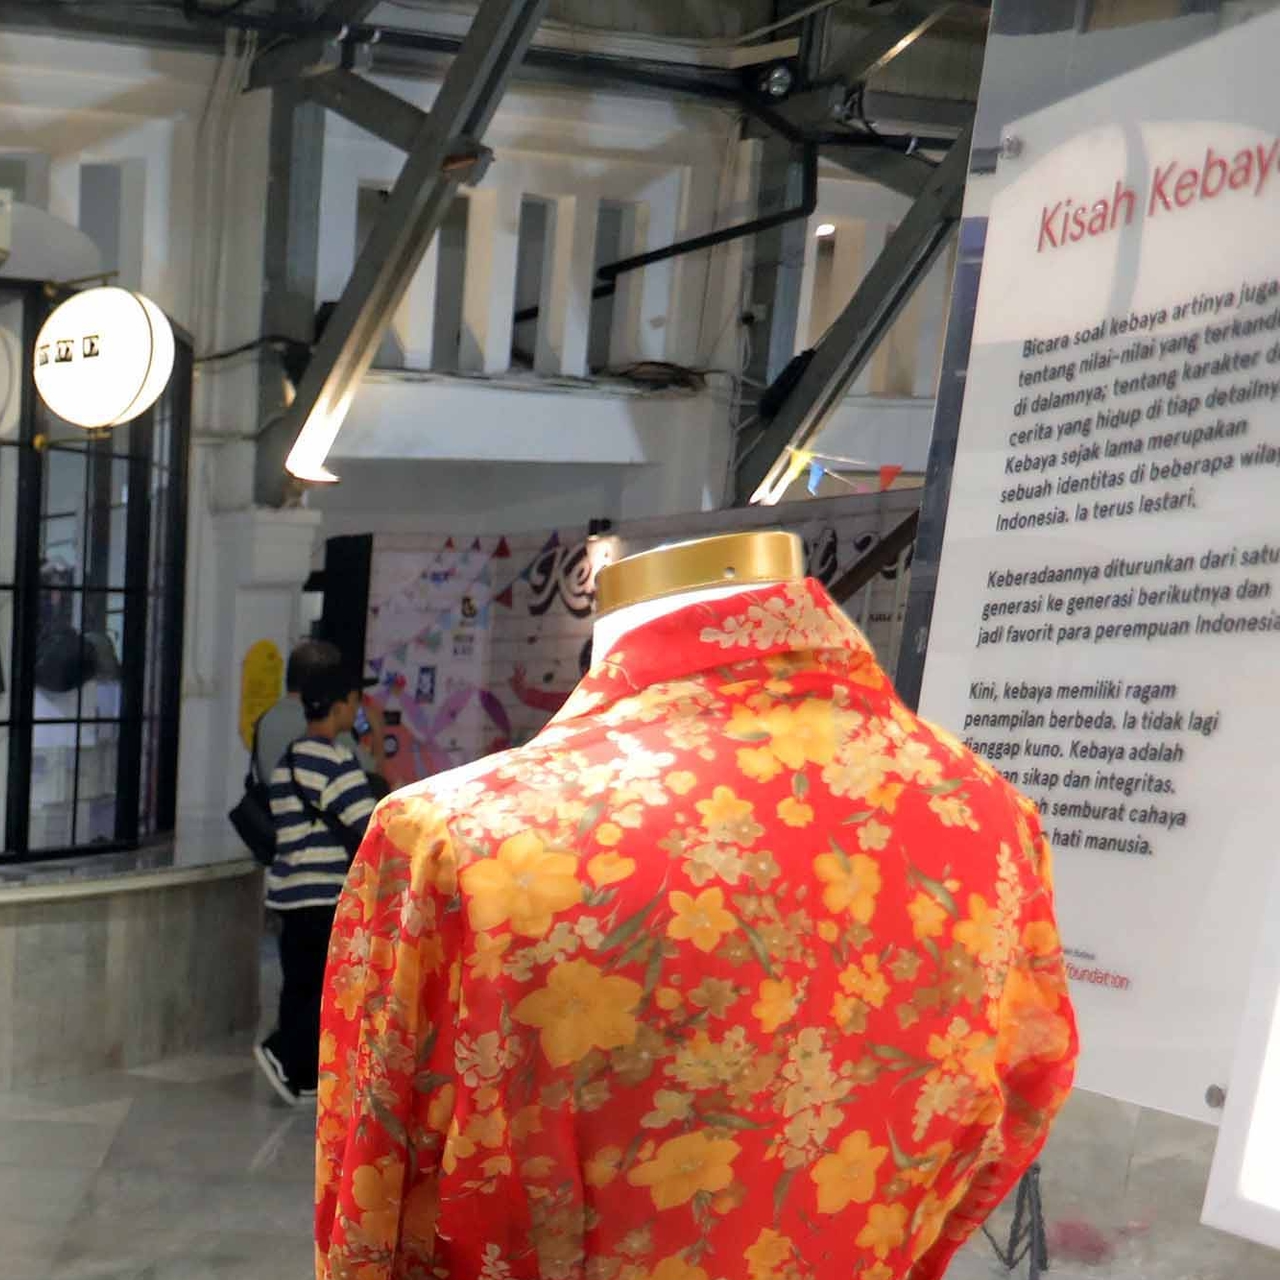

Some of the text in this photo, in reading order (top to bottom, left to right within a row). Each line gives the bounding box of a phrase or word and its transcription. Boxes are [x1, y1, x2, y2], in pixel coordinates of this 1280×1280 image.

[1037, 138, 1280, 253] Kisah Kebay
[1022, 280, 1280, 358] Bicara soal kebaya artinya juga
[1018, 307, 1280, 388] tentang nilai-nilai yang terkand
[1013, 397, 1028, 417] di
[1113, 369, 1178, 396] tentang
[1181, 350, 1261, 381] karakter
[1009, 423, 1053, 447] cerita
[1056, 418, 1092, 441] yang
[1095, 407, 1142, 430] hidup
[1146, 399, 1162, 419] di
[1167, 395, 1201, 417] tiap
[1004, 420, 1248, 474] Kebaya sejak lama merupakan
[1000, 479, 1052, 503] sebuah
[1056, 470, 1125, 495] identitas
[1129, 463, 1146, 484] di
[1149, 453, 1235, 481] beberapa
[996, 506, 1069, 532] Indonesia.
[1093, 500, 1135, 520] terus
[1138, 486, 1196, 514] lestari.
[987, 543, 1280, 588] Keberadaannya diturunkan dari satu
[981, 578, 1271, 621] generasi ke generasi berikutnya dan
[975, 625, 1004, 648] jadi
[1005, 623, 1054, 643] favorit
[1056, 625, 1092, 645] para
[1094, 620, 1191, 644] perempuan
[969, 679, 1177, 704] Kini, kebaya memiliki ragam
[963, 710, 1045, 732] penampilan
[1048, 710, 1117, 729] berbeda.
[1141, 710, 1184, 730] tidak
[1187, 710, 1221, 736] lagi
[1024, 739, 1063, 758] kuno.
[1069, 740, 1125, 764] Kebaya
[1128, 742, 1184, 761] adalah
[1022, 768, 1059, 790] sikap
[1063, 769, 1090, 788] dan
[1094, 770, 1176, 796] integritas.
[1051, 800, 1126, 821] semburat
[1129, 804, 1187, 829] cahaya
[1051, 827, 1153, 855] hati manusia.
